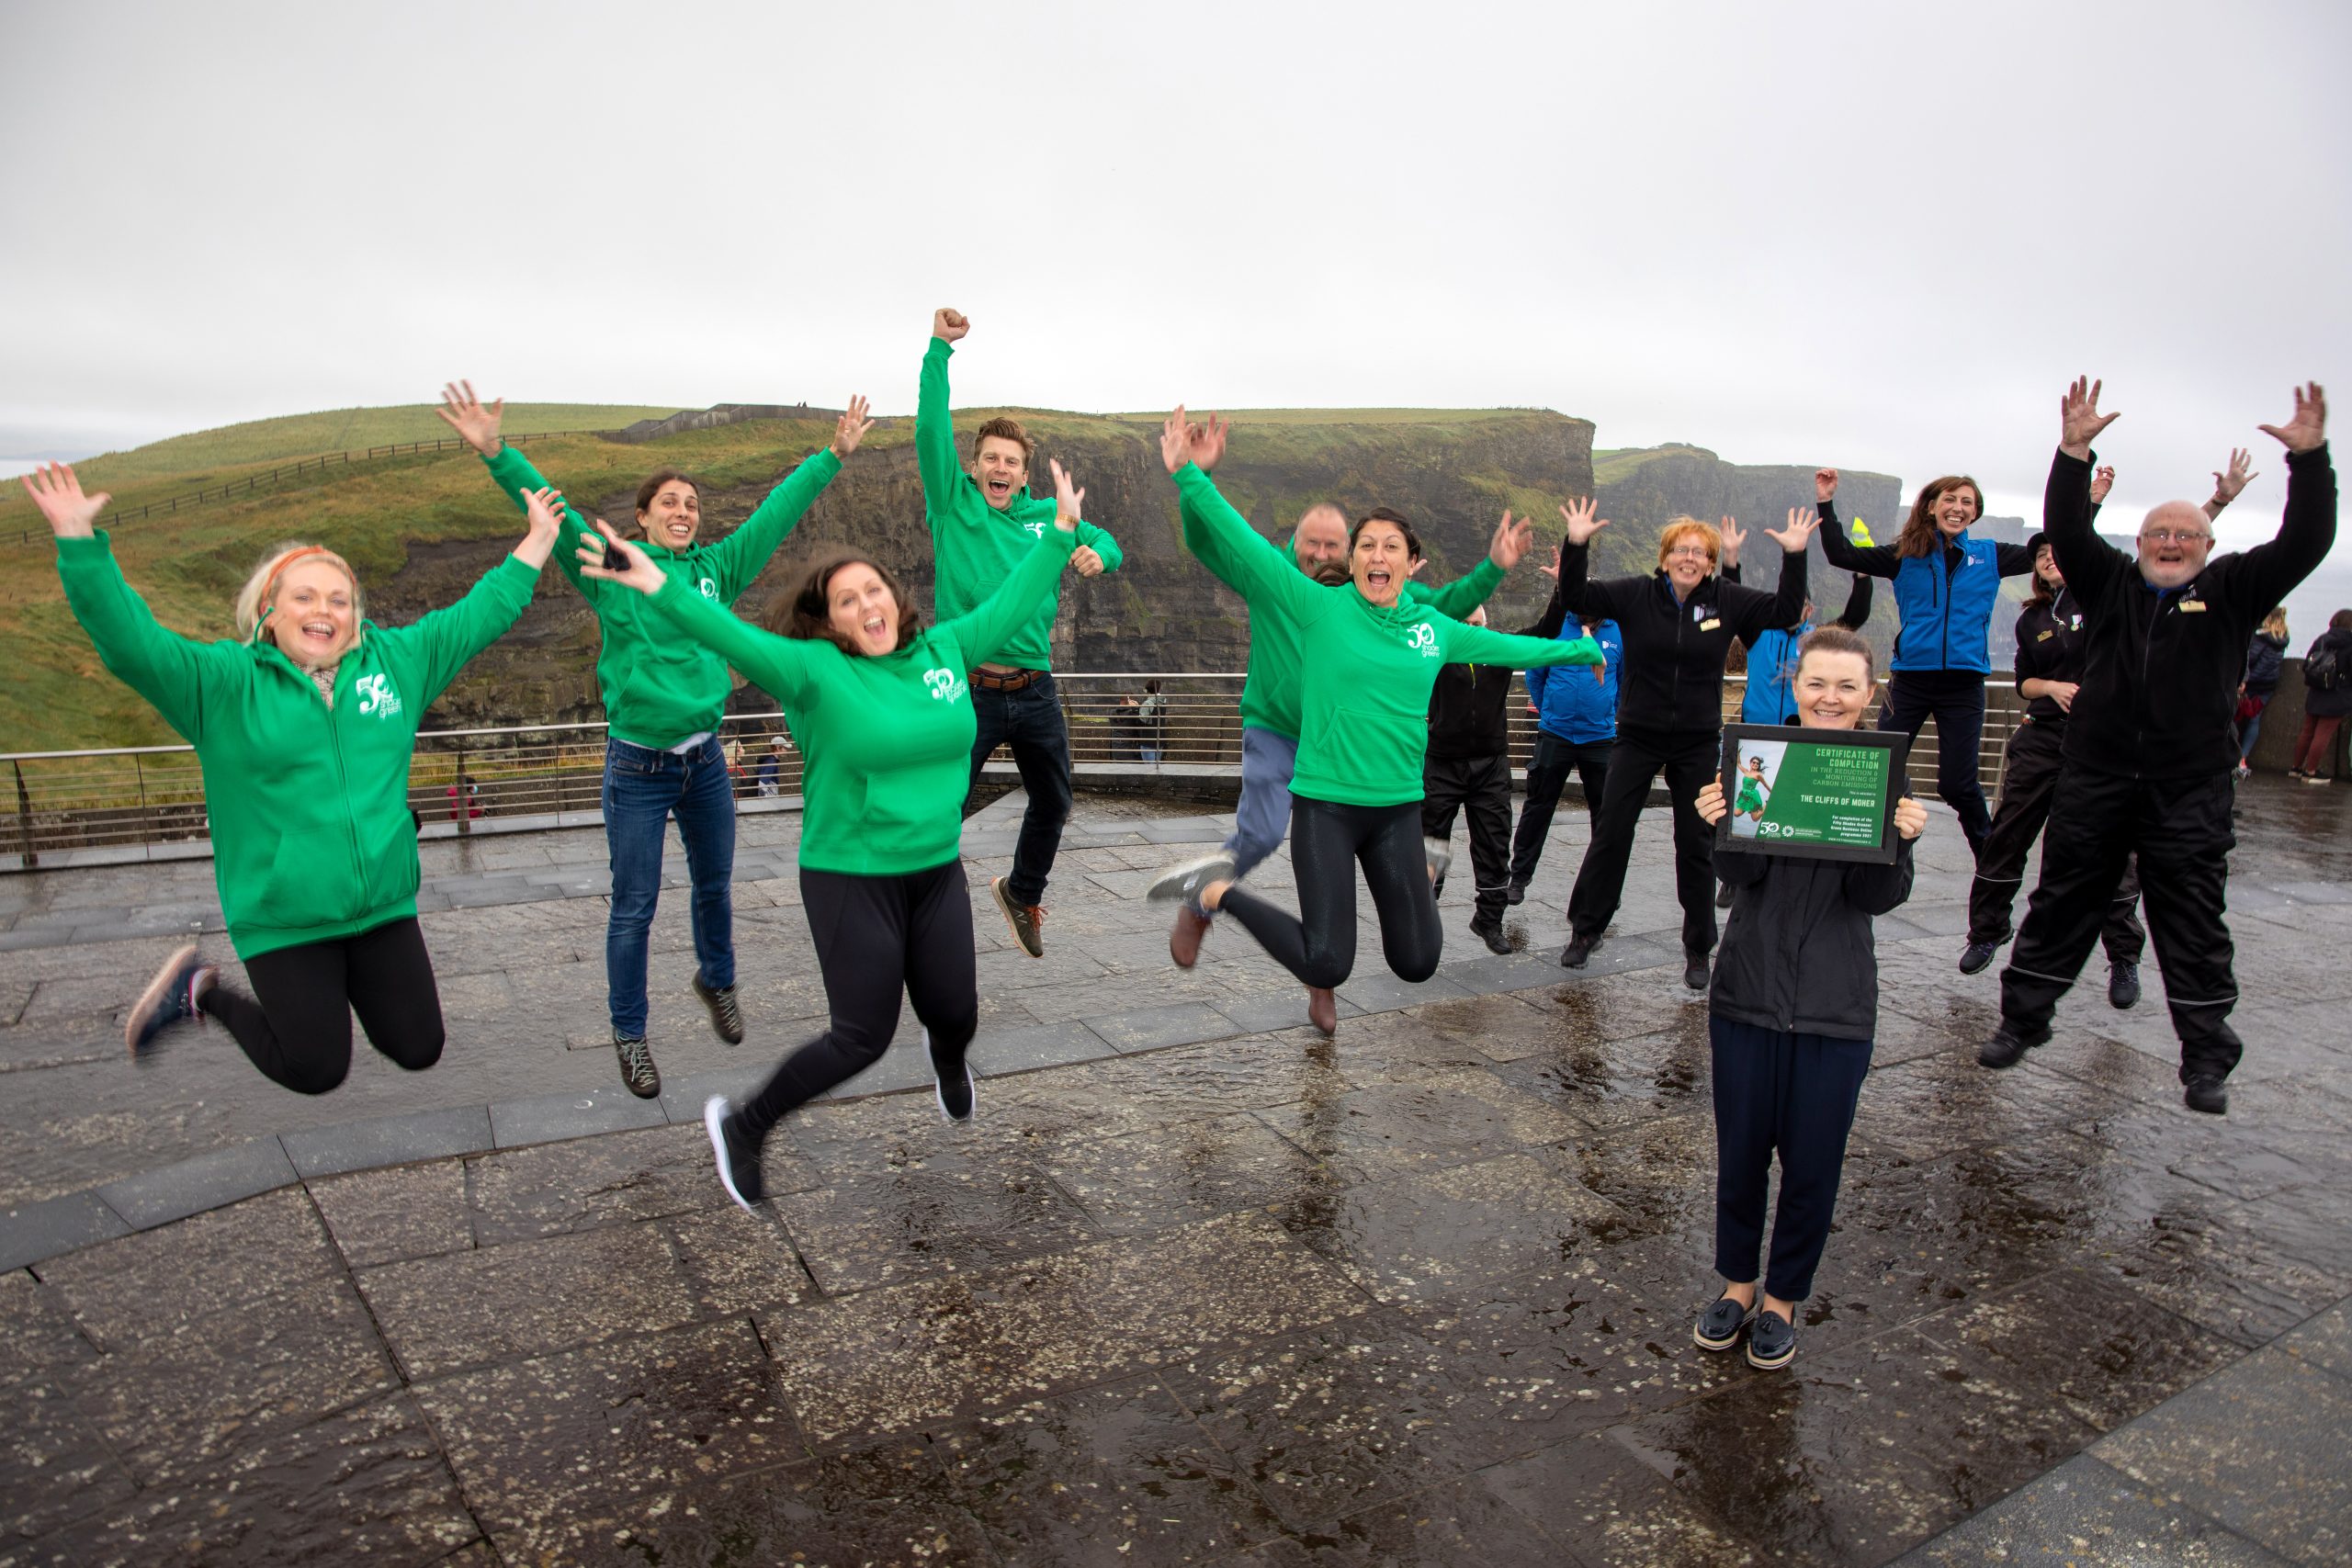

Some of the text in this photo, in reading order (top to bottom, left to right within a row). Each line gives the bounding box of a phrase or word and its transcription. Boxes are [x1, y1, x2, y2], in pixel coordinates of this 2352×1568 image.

[1407, 622, 1435, 649] 50
[1815, 748, 1881, 760] CERTIFICATE OF
[1829, 759, 1879, 770] COMPLETION
[1834, 768, 1872, 776] REDUCTION
[1813, 779, 1877, 789] CARBON EMISSIONS
[1825, 774, 1867, 783] MONITORING
[1801, 795, 1875, 807] THE CLIFFS OF MOHER
[1759, 821, 1780, 834] 50
